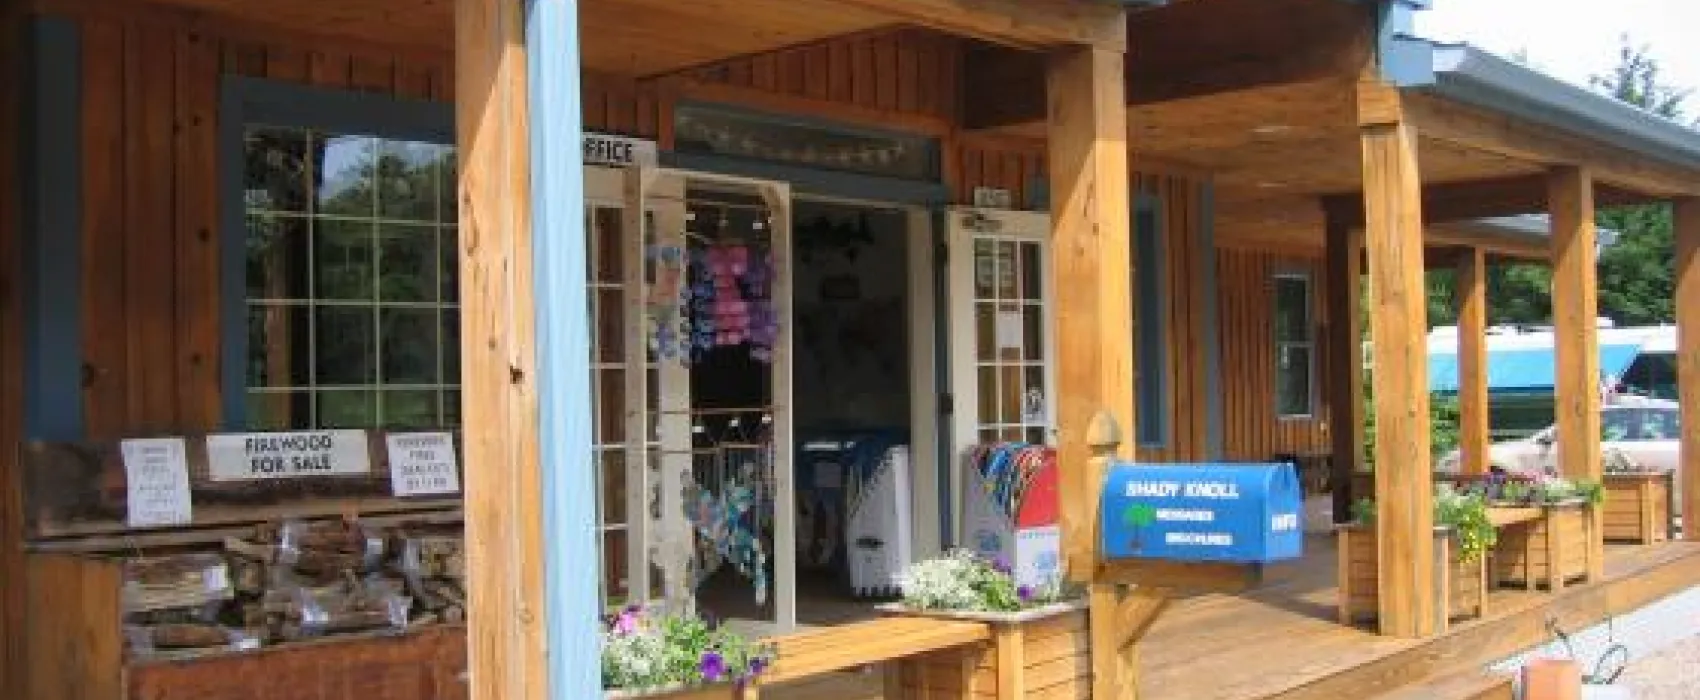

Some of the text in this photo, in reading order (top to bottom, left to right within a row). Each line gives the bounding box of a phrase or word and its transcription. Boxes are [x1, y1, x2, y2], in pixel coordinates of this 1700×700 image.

[582, 137, 633, 163] FFICE
[245, 435, 332, 454] FIREWOOD
[251, 453, 332, 473] FOR SALE
[1125, 481, 1240, 500] SHADY KNOLL
